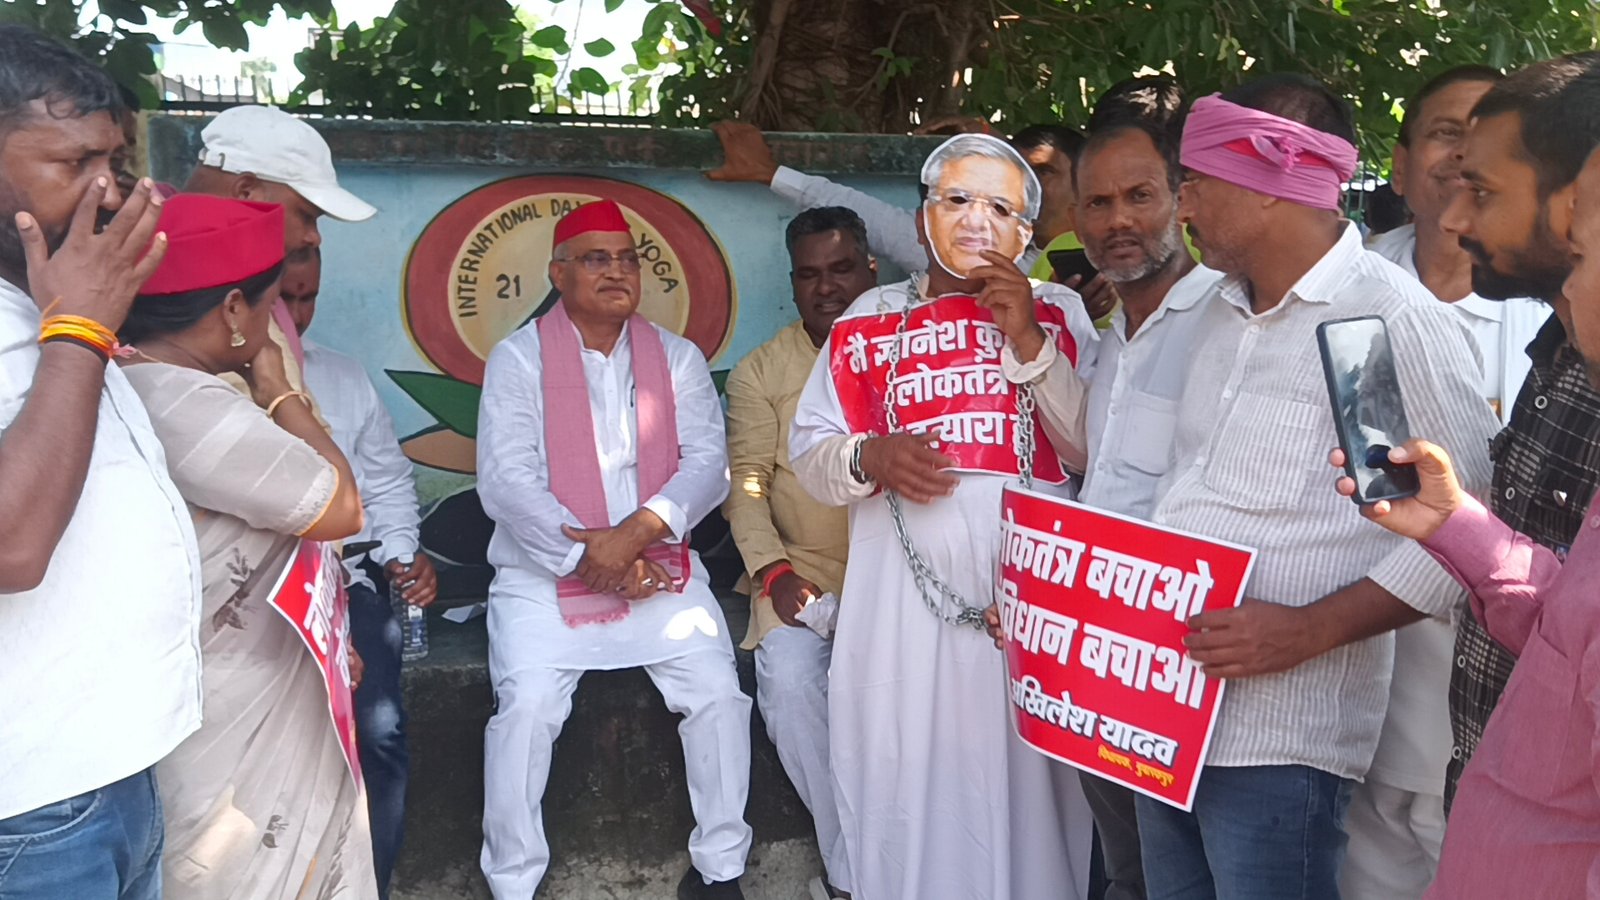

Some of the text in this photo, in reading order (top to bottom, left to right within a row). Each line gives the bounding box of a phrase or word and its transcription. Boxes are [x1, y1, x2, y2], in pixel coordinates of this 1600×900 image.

[457, 203, 543, 318] INTERNATIONAL
[635, 232, 680, 294] YOGA
[496, 273, 521, 299] 21
[893, 354, 1008, 407] लोकतंत्र
[1085, 545, 1215, 623] बचाओ
[1098, 714, 1179, 767] यादव
